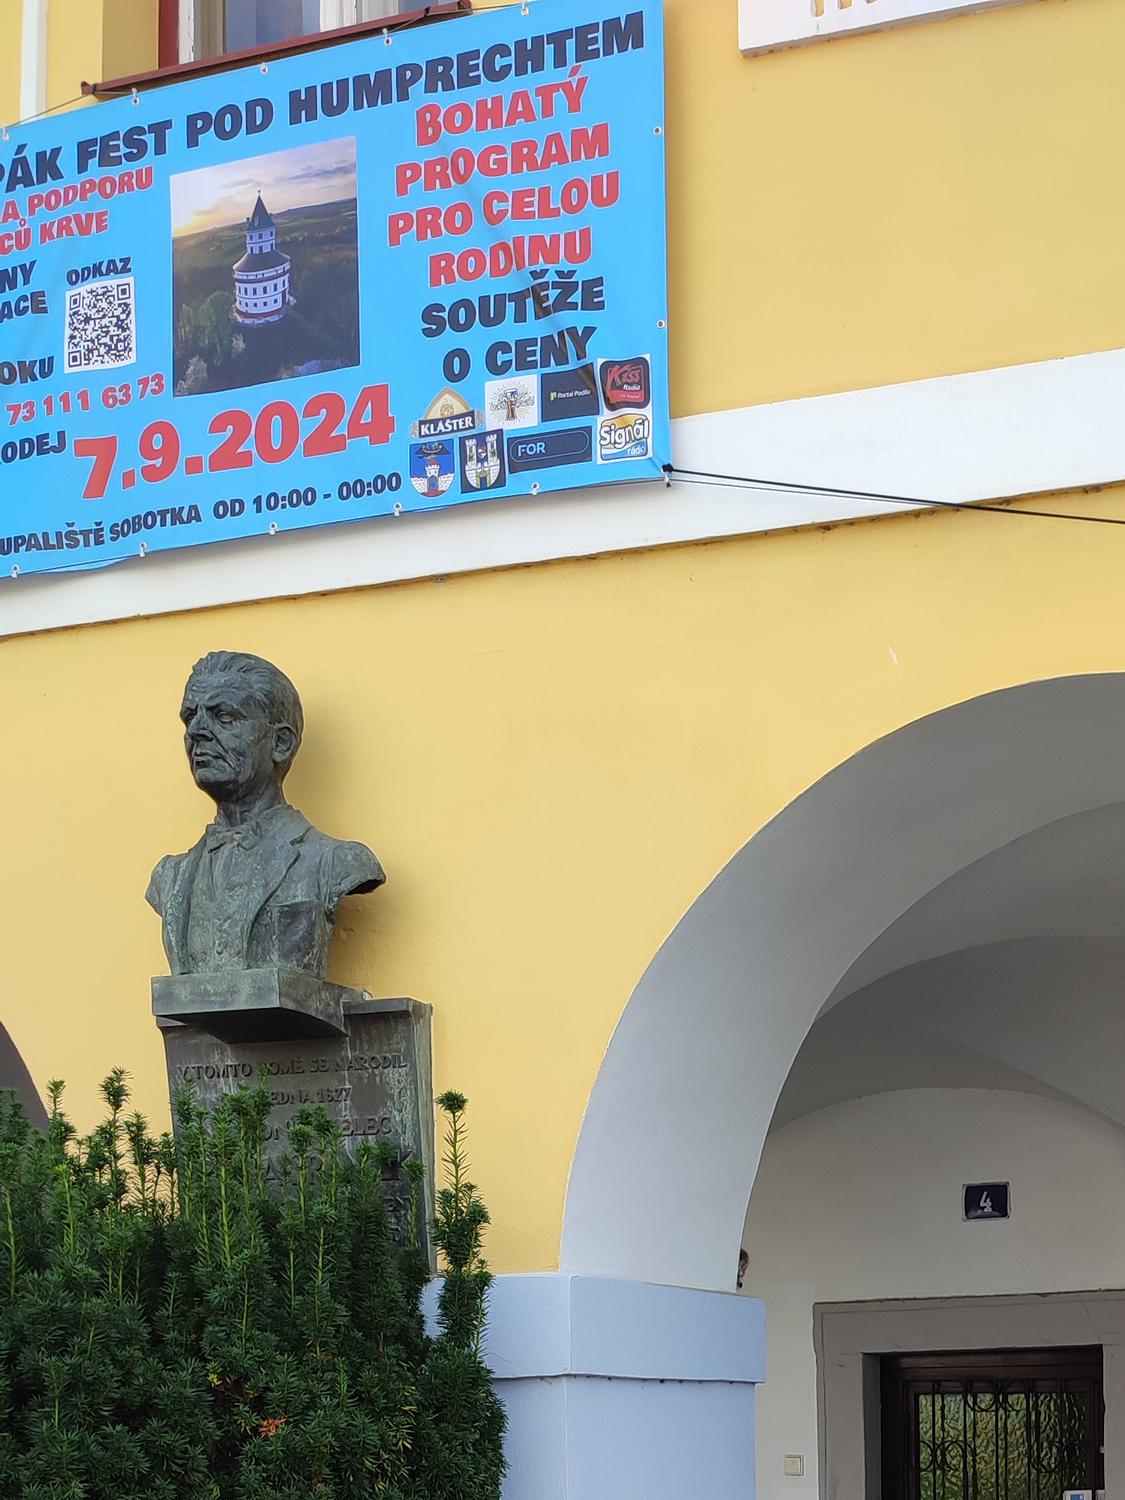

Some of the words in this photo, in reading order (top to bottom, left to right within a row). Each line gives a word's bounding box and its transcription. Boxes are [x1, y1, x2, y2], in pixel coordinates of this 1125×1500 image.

[0, 143, 64, 193] ÁK
[76, 119, 174, 175] FEST
[186, 98, 274, 149] POD
[288, 10, 645, 126] HUMPRECHTEM
[415, 64, 589, 147] BOHATÝ
[396, 122, 610, 197] PROGRAM
[28, 166, 153, 217] PODPORU
[388, 201, 473, 247] PRO
[482, 170, 620, 226] CELOU
[39, 210, 109, 245] KRVE
[66, 256, 131, 286] ODKAZ
[429, 226, 592, 288] RODINU
[421, 268, 606, 338] SOUTĚŽE
[442, 347, 471, 383] O
[484, 326, 597, 376] CENY
[6, 400, 36, 426] 73
[420, 416, 474, 436] KLÁŠTER
[600, 418, 649, 449] Signál
[73, 383, 395, 499] 7.9.2024
[517, 440, 546, 457] FOR
[109, 504, 202, 542] SOBOTKA
[213, 498, 245, 520] OD
[253, 487, 317, 514] 10:00
[337, 472, 402, 501] 00:00
[195, 1063, 253, 1080] TOMTO
[260, 1056, 305, 1076] OMĚ
[310, 1060, 330, 1075] SE
[335, 1053, 408, 1074] NARODIL
[979, 1191, 992, 1212] 4
